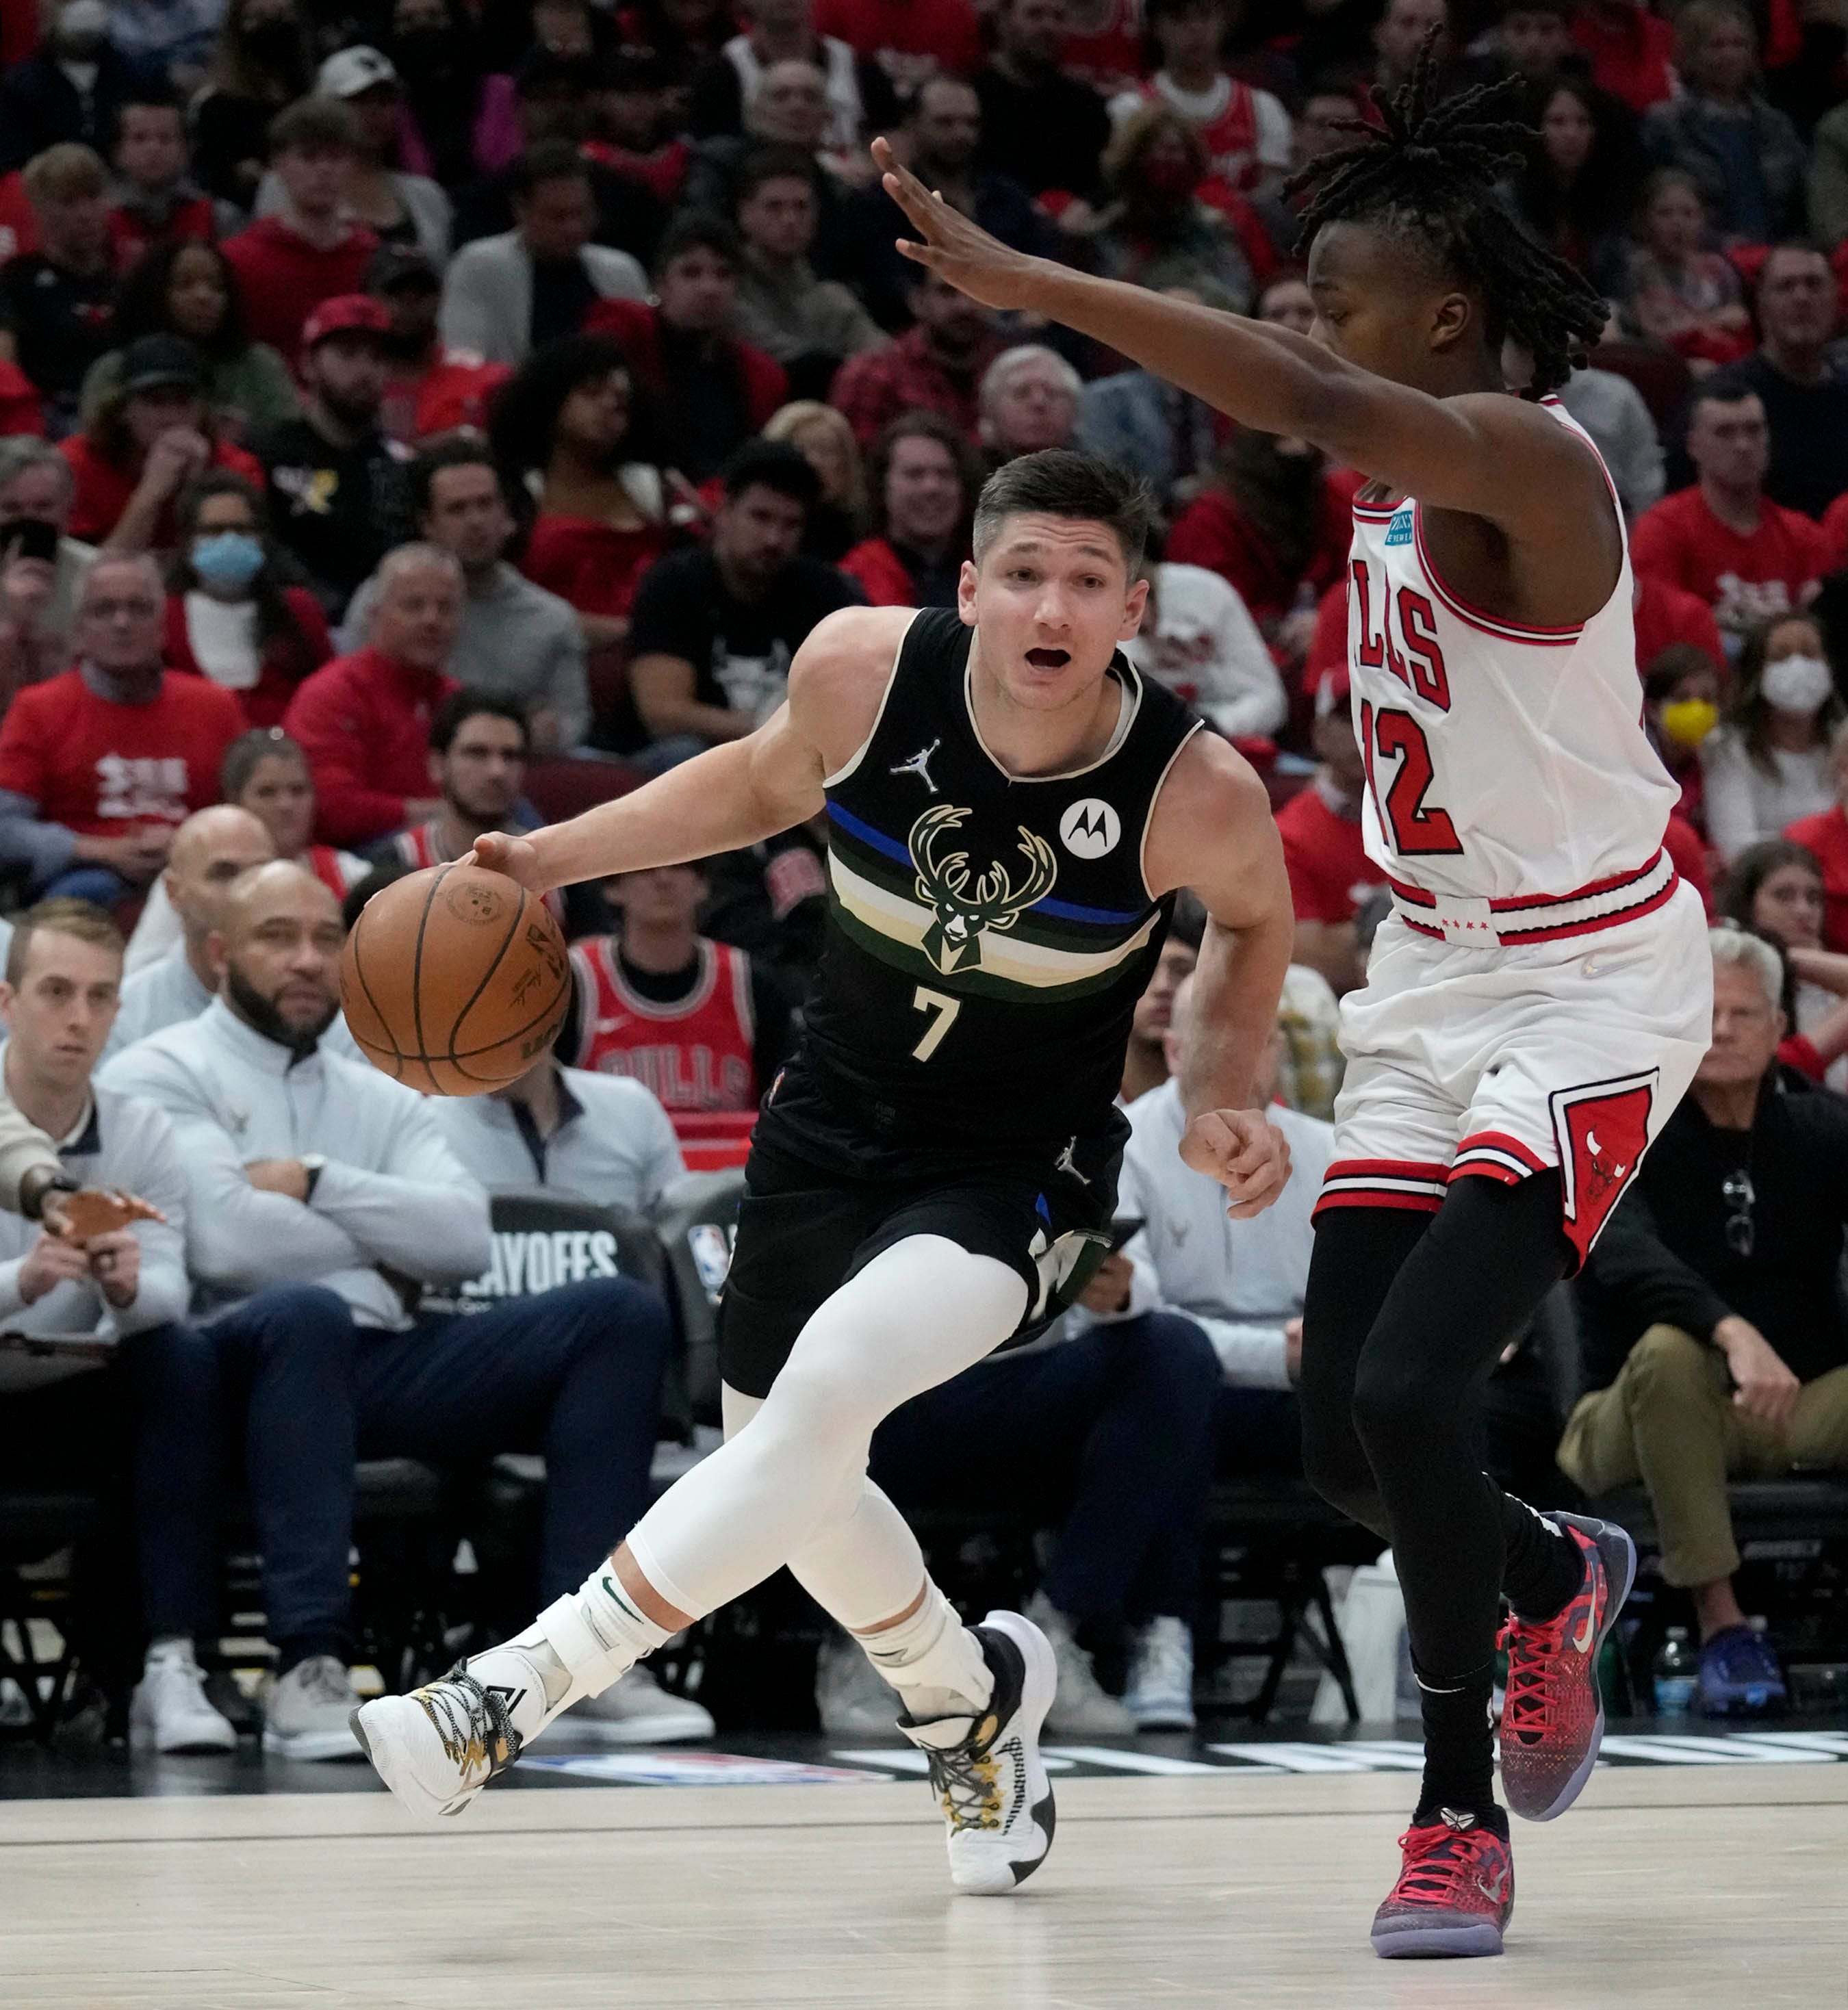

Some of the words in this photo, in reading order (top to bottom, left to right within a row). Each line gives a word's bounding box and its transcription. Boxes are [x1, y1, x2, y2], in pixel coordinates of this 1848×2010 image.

[1361, 697, 1464, 855] 12
[912, 985, 961, 1063] 7
[461, 1231, 618, 1296] AYOFFS
